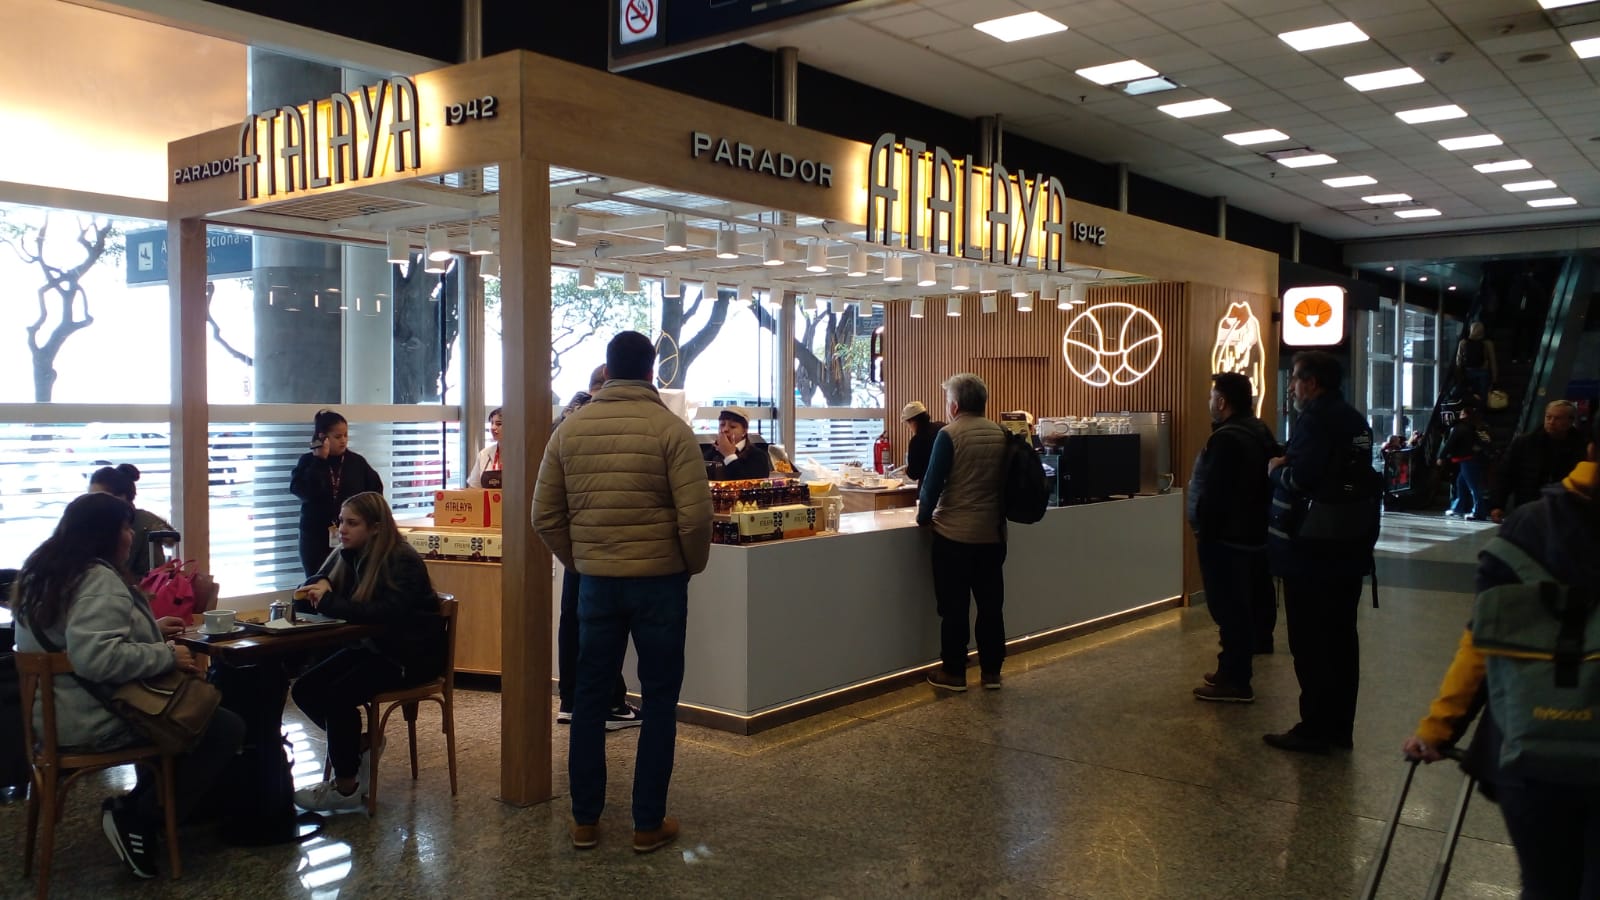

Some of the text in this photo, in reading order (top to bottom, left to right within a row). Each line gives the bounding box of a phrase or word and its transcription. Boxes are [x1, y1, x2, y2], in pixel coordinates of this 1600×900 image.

[238, 75, 422, 200] ATALAYA
[445, 95, 498, 126] 1942
[691, 131, 1108, 273] PARADOR ATALAYA 1942
[445, 501, 473, 512] ATALAYA
